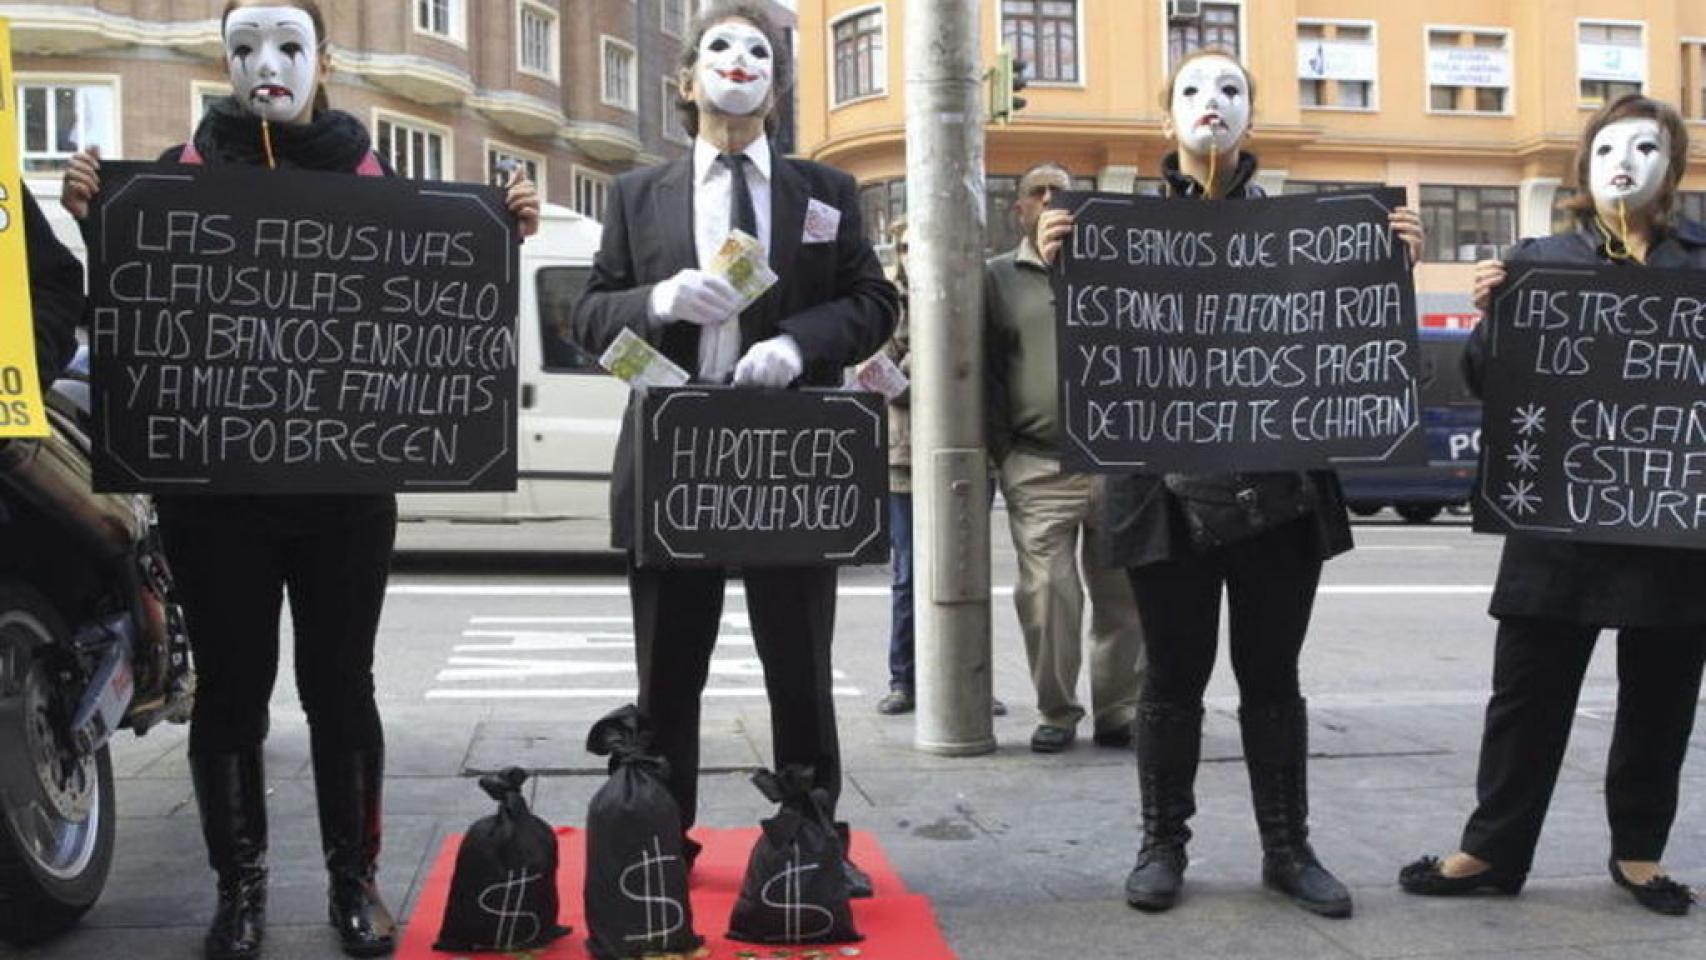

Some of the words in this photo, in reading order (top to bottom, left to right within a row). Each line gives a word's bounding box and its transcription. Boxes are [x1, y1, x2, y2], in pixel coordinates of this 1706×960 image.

[137, 211, 235, 255] LAS
[255, 219, 475, 266] ABUSIVAS
[1072, 225, 1117, 260] LOS
[1127, 228, 1216, 266] BANCOS
[1227, 233, 1278, 268] QUE
[1288, 223, 1392, 264] ROBAN
[110, 262, 365, 314] CLAUSULAS
[381, 276, 499, 321] SUELO
[1067, 284, 1110, 326] LES
[1116, 289, 1183, 334] PONEN
[1195, 293, 1217, 335] LA
[1223, 290, 1324, 335] ALFOMBA
[1336, 283, 1401, 328] ROJA
[1514, 290, 1569, 330] LAS
[1578, 292, 1662, 334] TRES
[95, 308, 119, 357] A
[133, 309, 194, 359] LOS
[206, 315, 343, 364] BANCOS
[351, 317, 517, 370] ENRIQUECEN
[1536, 334, 1594, 375] LOS
[1622, 340, 1706, 384] BAN
[1080, 345, 1097, 386] Y
[1100, 346, 1121, 385] SI
[1133, 346, 1164, 387] TU
[1169, 346, 1196, 388] NO
[1205, 345, 1305, 389] PUEDES
[1316, 340, 1410, 386] PAGAR
[127, 366, 151, 410] Y
[159, 365, 181, 406] A
[192, 367, 279, 410] MILES
[286, 369, 327, 412] DE
[338, 370, 496, 415] FAMILIAS
[148, 416, 459, 465] EMPOBRECEN
[1088, 400, 1119, 441] DE
[1124, 400, 1155, 441] TU
[1162, 400, 1236, 443] CASA
[1248, 400, 1282, 442] TE
[1293, 388, 1410, 441] ECHARAN
[672, 426, 856, 480] HIPOTECAS
[1563, 442, 1706, 488] ESTAF
[666, 483, 786, 531] CLAUSULA
[789, 483, 859, 530] SUELO
